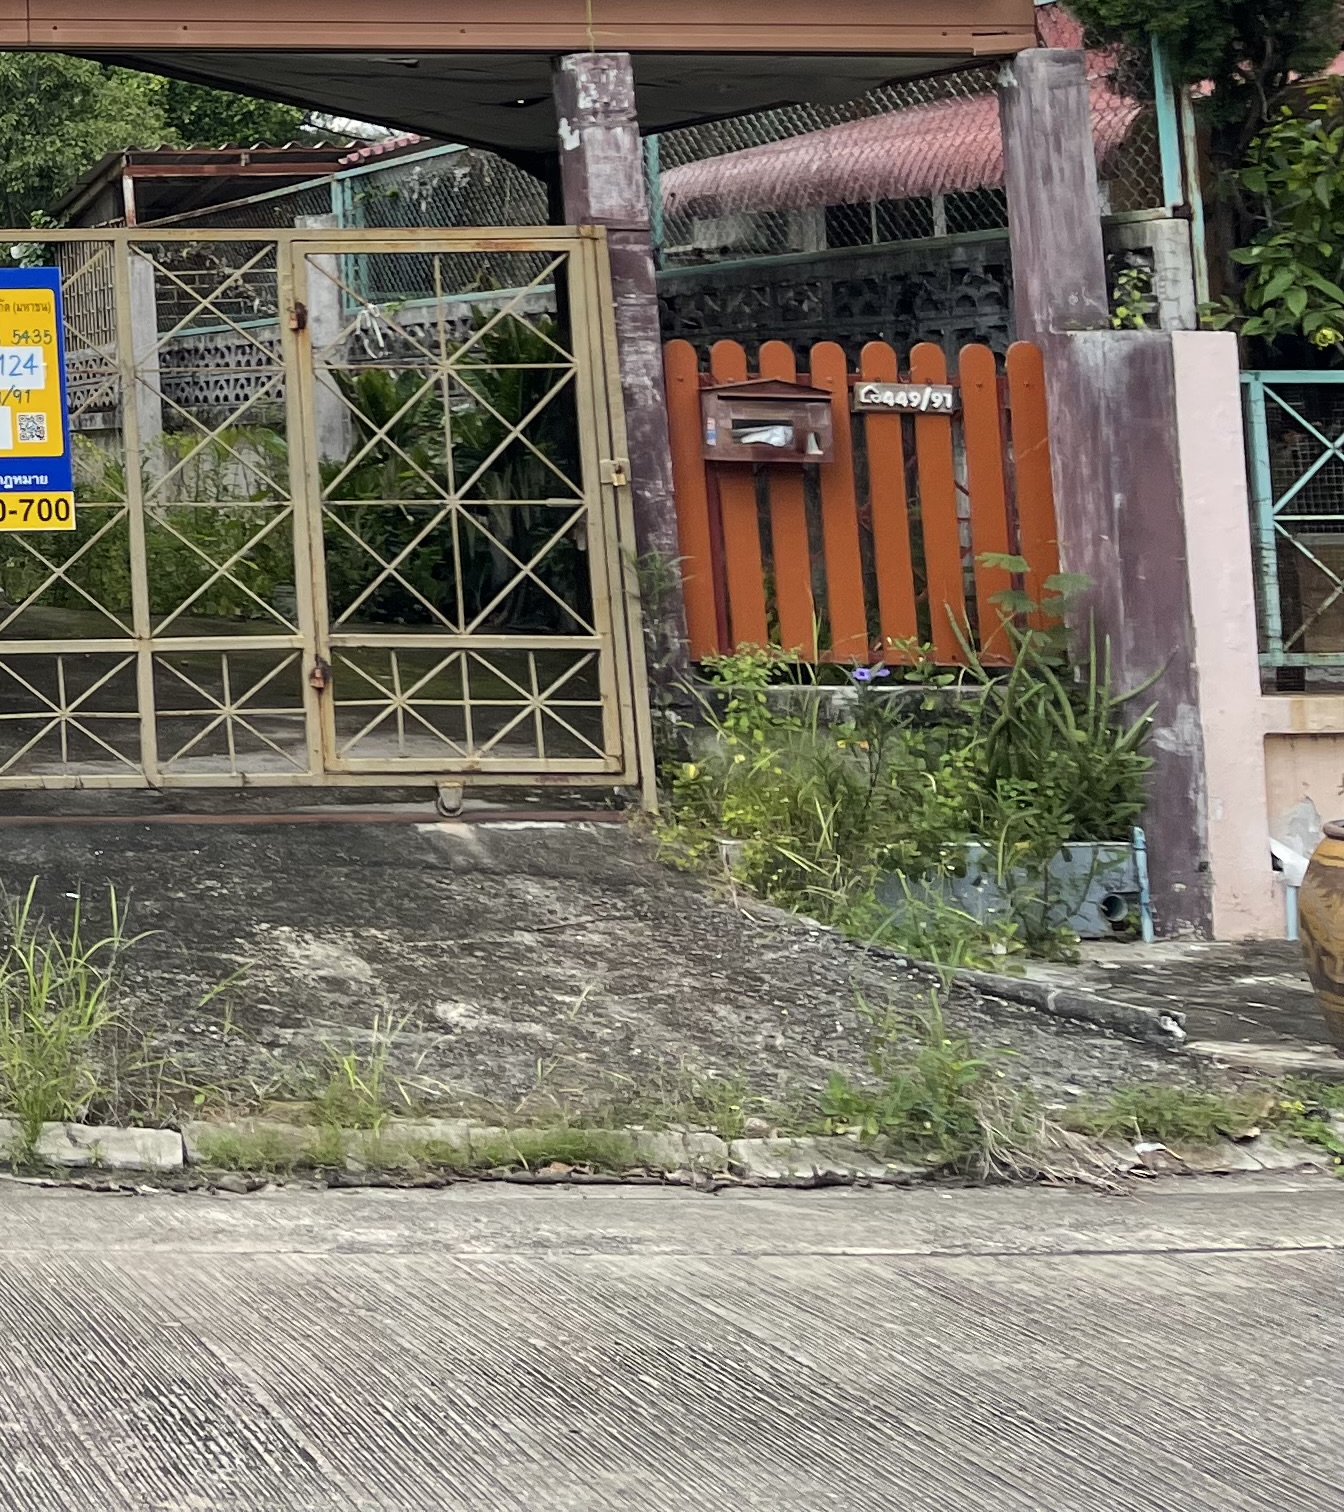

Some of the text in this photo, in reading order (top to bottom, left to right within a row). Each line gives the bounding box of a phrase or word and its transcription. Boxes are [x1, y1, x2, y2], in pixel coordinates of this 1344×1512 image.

[12, 300, 51, 315] (มหาชน)
[10, 328, 53, 345] 5435
[882, 386, 953, 412] 449/91
